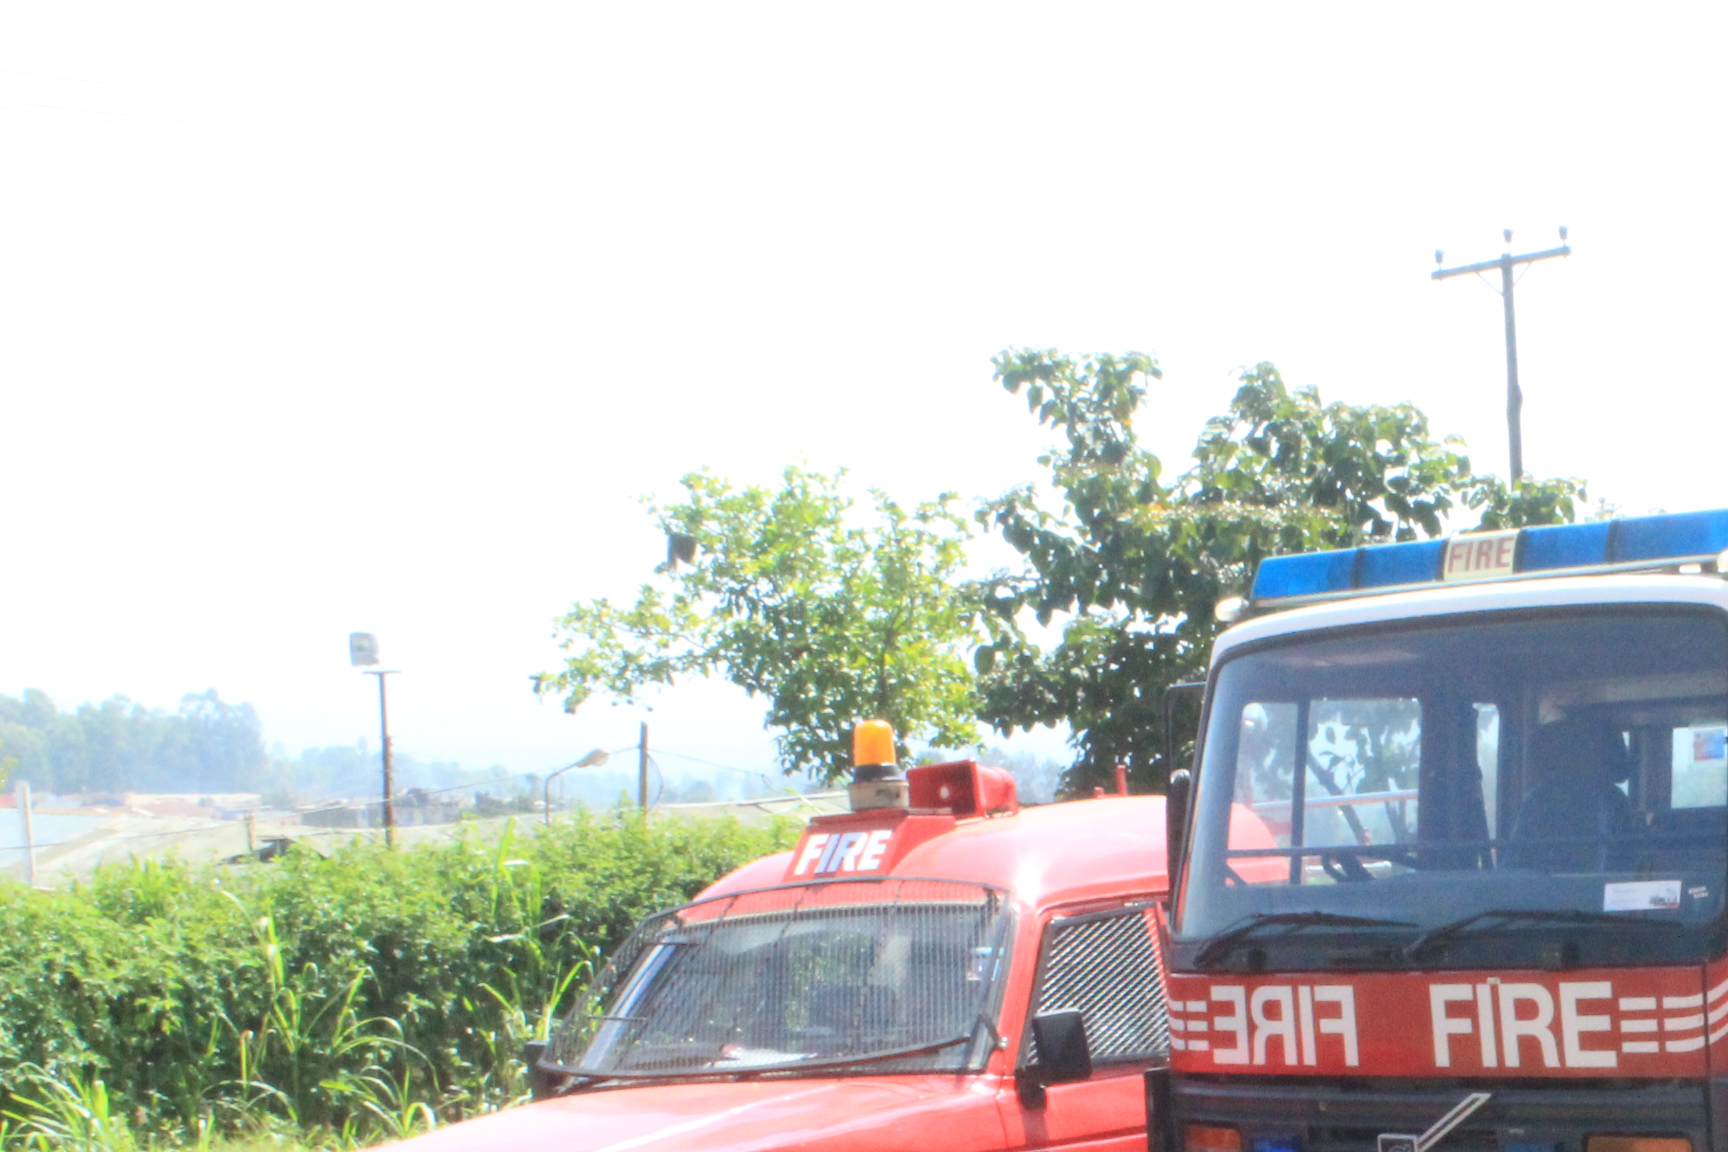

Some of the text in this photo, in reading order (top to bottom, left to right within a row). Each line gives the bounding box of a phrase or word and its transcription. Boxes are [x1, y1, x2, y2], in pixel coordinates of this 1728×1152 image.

[1447, 536, 1513, 574] FIRE
[794, 828, 893, 877] FIRE
[1429, 979, 1618, 1069] FIRE
